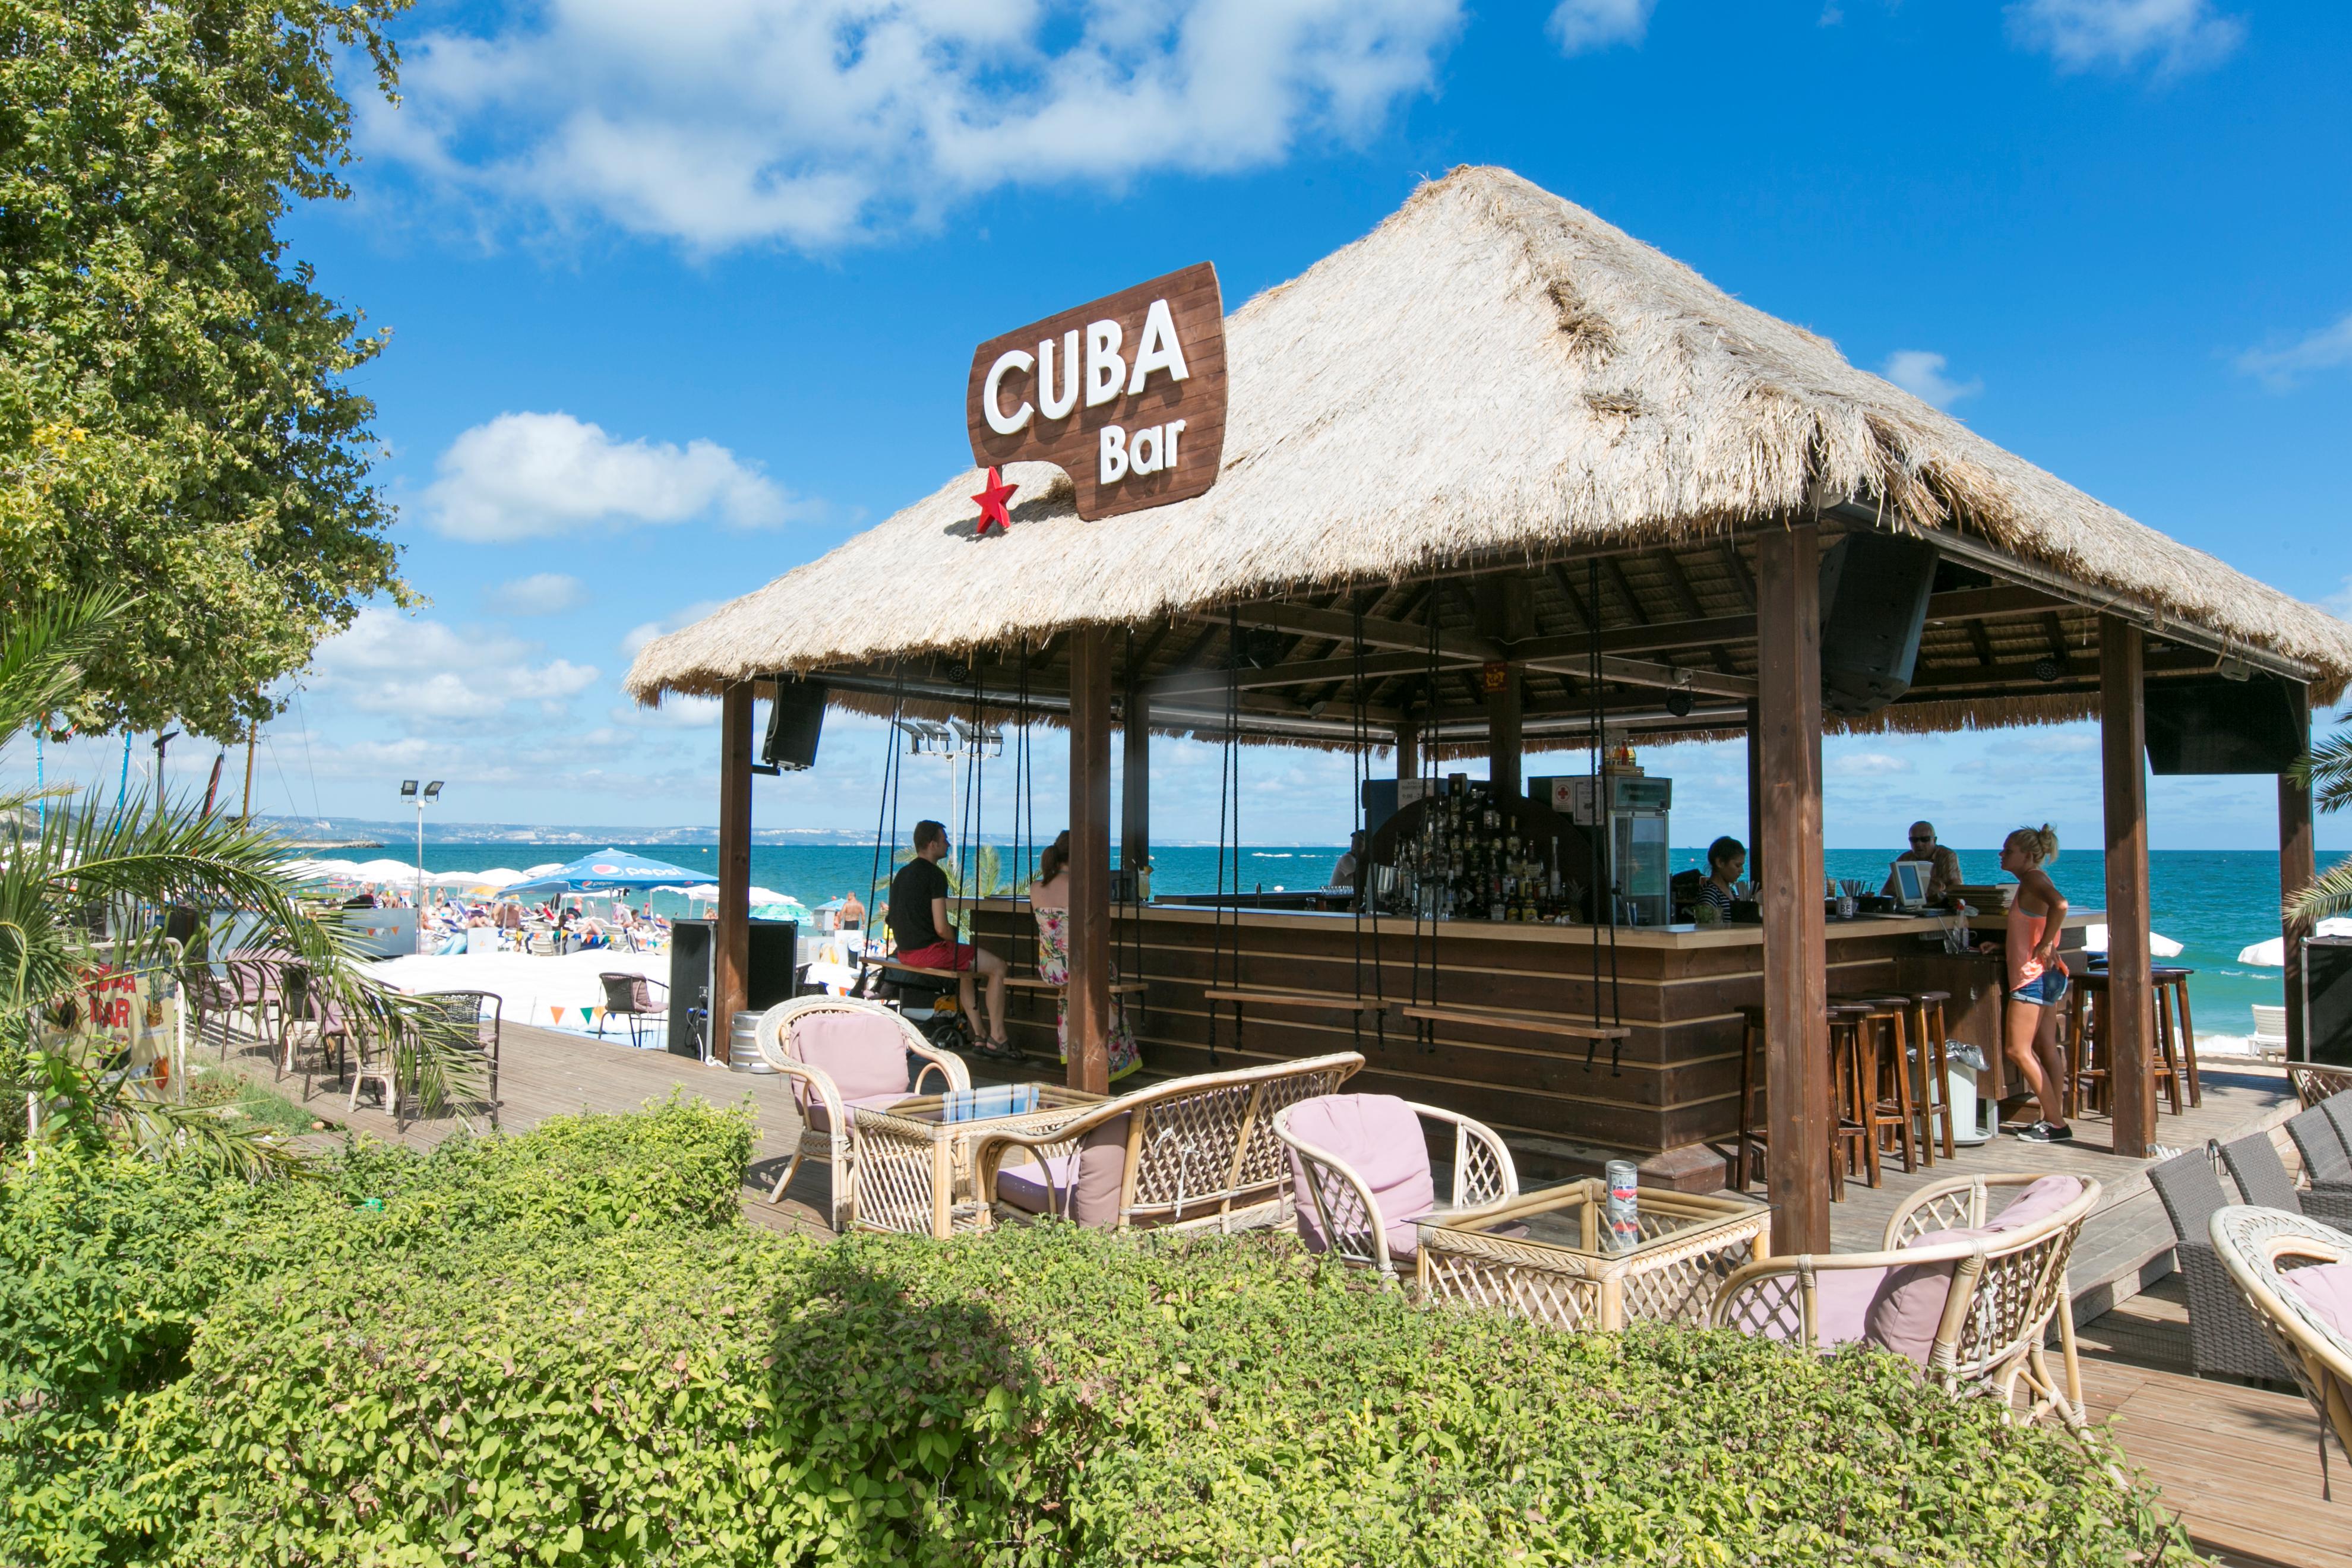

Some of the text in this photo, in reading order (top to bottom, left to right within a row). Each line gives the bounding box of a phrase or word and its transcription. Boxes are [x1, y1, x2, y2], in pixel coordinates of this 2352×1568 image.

[984, 299, 1189, 434] CUBA
[1101, 419, 1187, 485] Bar
[625, 867, 683, 877] pepsi
